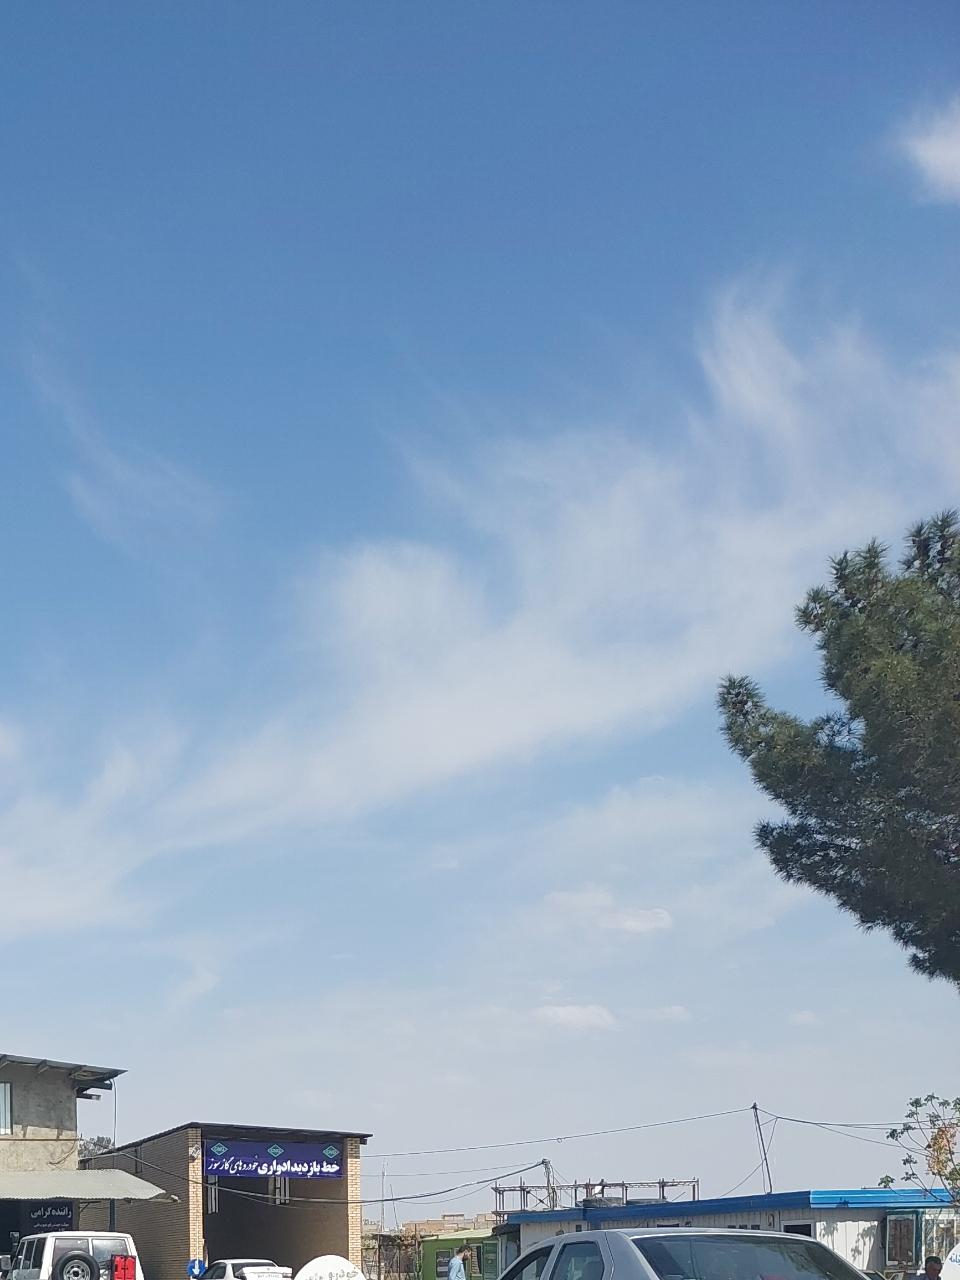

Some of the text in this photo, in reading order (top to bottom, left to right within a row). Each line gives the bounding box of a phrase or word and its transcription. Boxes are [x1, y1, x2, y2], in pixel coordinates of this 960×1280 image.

[258, 1159, 290, 1175] ادواری
[291, 1159, 321, 1177] بازدید
[321, 1160, 340, 1173] خط
[30, 1206, 72, 1218] راننده گرامی
